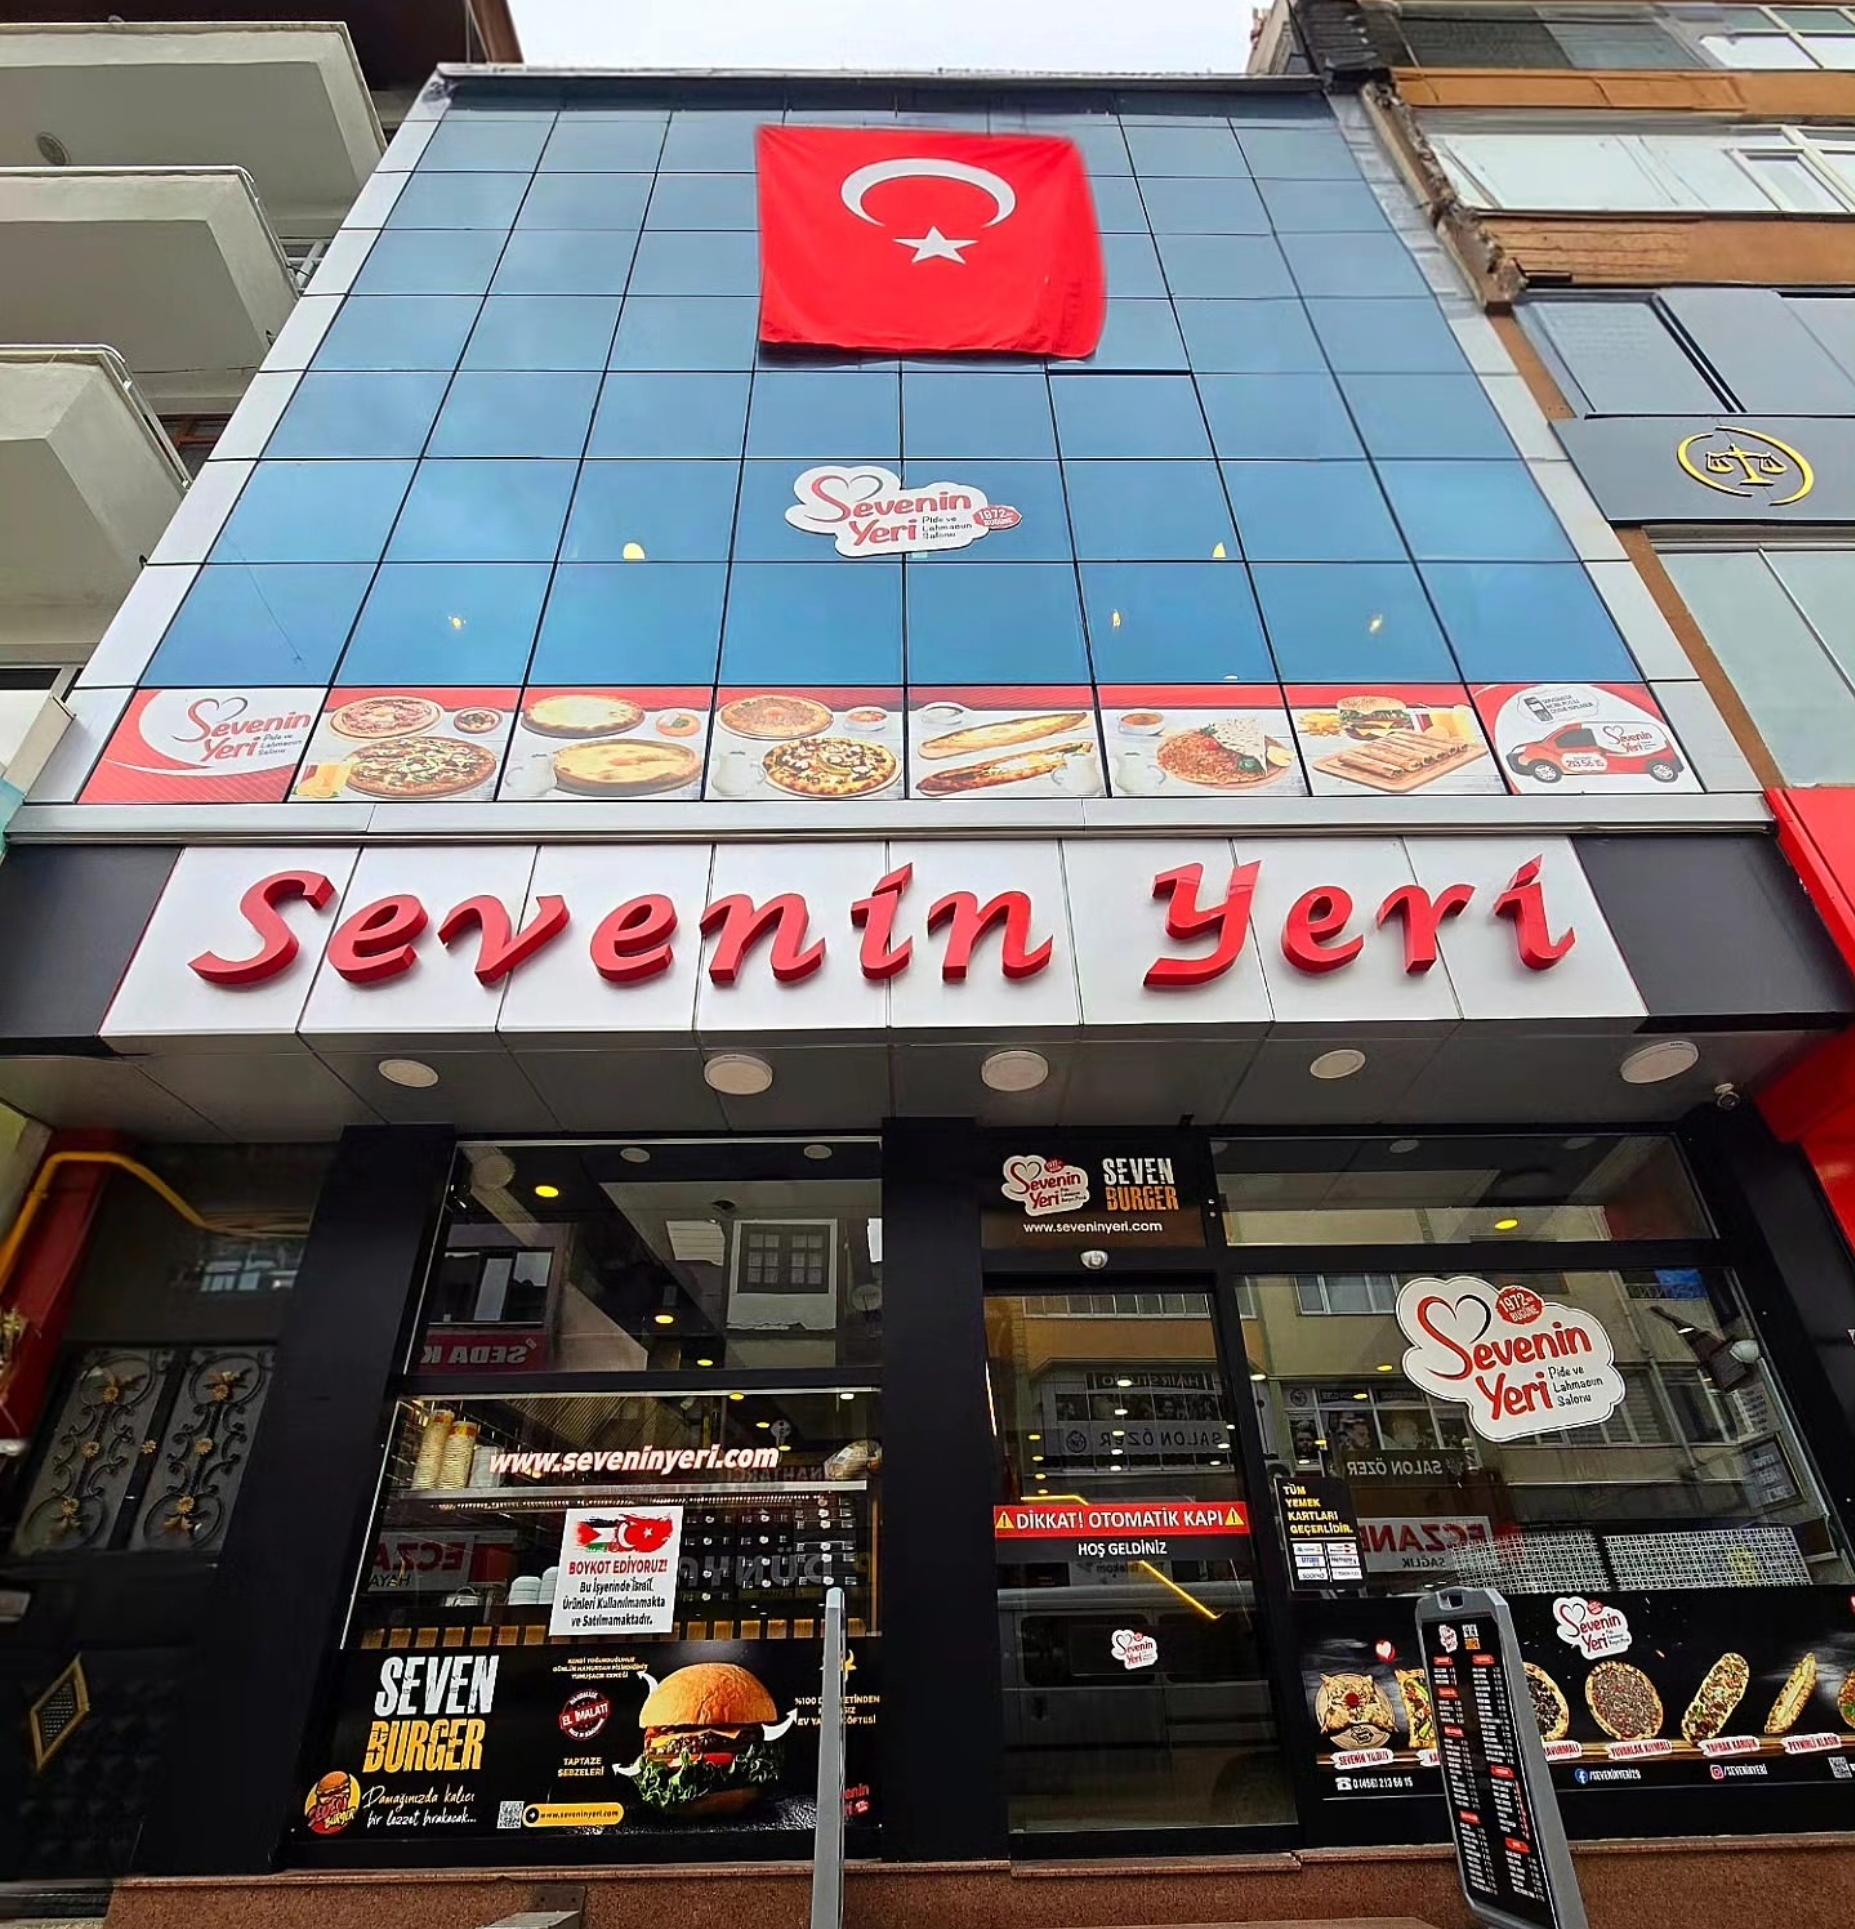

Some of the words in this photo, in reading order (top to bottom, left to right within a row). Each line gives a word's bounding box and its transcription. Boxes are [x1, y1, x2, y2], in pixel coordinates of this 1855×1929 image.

[804, 475, 971, 523] Sevenin
[979, 509, 1007, 520] 1972
[849, 519, 917, 546] Yeri
[170, 697, 311, 743] Sevenin
[201, 736, 261, 762] Yeri
[187, 862, 1053, 989] Sevenin
[1010, 1161, 1081, 1194] Sevenin
[1103, 1158, 1175, 1185] SEVEN
[1030, 1191, 1061, 1209] Yeri
[1106, 1186, 1179, 1211] BURGER
[1023, 1220, 1163, 1234] www.seveninyeri.com
[1499, 1292, 1529, 1313] 1972
[1418, 1294, 1592, 1381] Sevenin
[1548, 1366, 1571, 1379] Pide
[1572, 1366, 1584, 1375] ve
[1552, 1377, 1604, 1393] Lahmacun
[1476, 1371, 1553, 1421] Yeri
[1557, 1394, 1592, 1407] Salonu
[489, 1444, 779, 1475] www.seveninyeri.com
[1282, 1483, 1306, 1495] TÜM
[1285, 1498, 1321, 1508] YEMEK
[1016, 1509, 1083, 1530] DİKKAT!
[1089, 1507, 1180, 1528] OTOMATİK
[1184, 1509, 1223, 1526] KAPI
[1288, 1511, 1338, 1521] KARTLARI
[1290, 1523, 1354, 1536] GEÇERLİDİR.
[1078, 1542, 1105, 1558] HOŞ
[1108, 1539, 1167, 1556] GELDİNİZ
[568, 1560, 611, 1575] BOYKOT
[613, 1555, 668, 1573] EDİYORUZ!
[579, 1581, 591, 1593] Bu
[571, 1618, 581, 1627] ve
[1560, 1603, 1621, 1637] Sevenin
[1115, 1632, 1153, 1657] Sevenin
[1581, 1633, 1608, 1653] Yeri
[1126, 1652, 1143, 1665] Yeri
[374, 1655, 500, 1717] SEVEN
[795, 1697, 817, 1705] %100
[562, 1715, 573, 1726] EL
[362, 1718, 486, 1773] BURGER
[1544, 1744, 1580, 1755] AVURMALI
[558, 1766, 605, 1777] SEBZELERİ
[563, 1757, 602, 1766] TAPTAZE
[362, 1785, 438, 1813] Damağınızda
[367, 1809, 383, 1829] bir
[386, 1809, 421, 1827] lezzet
[540, 1809, 618, 1819] www.seveninyeri.com
